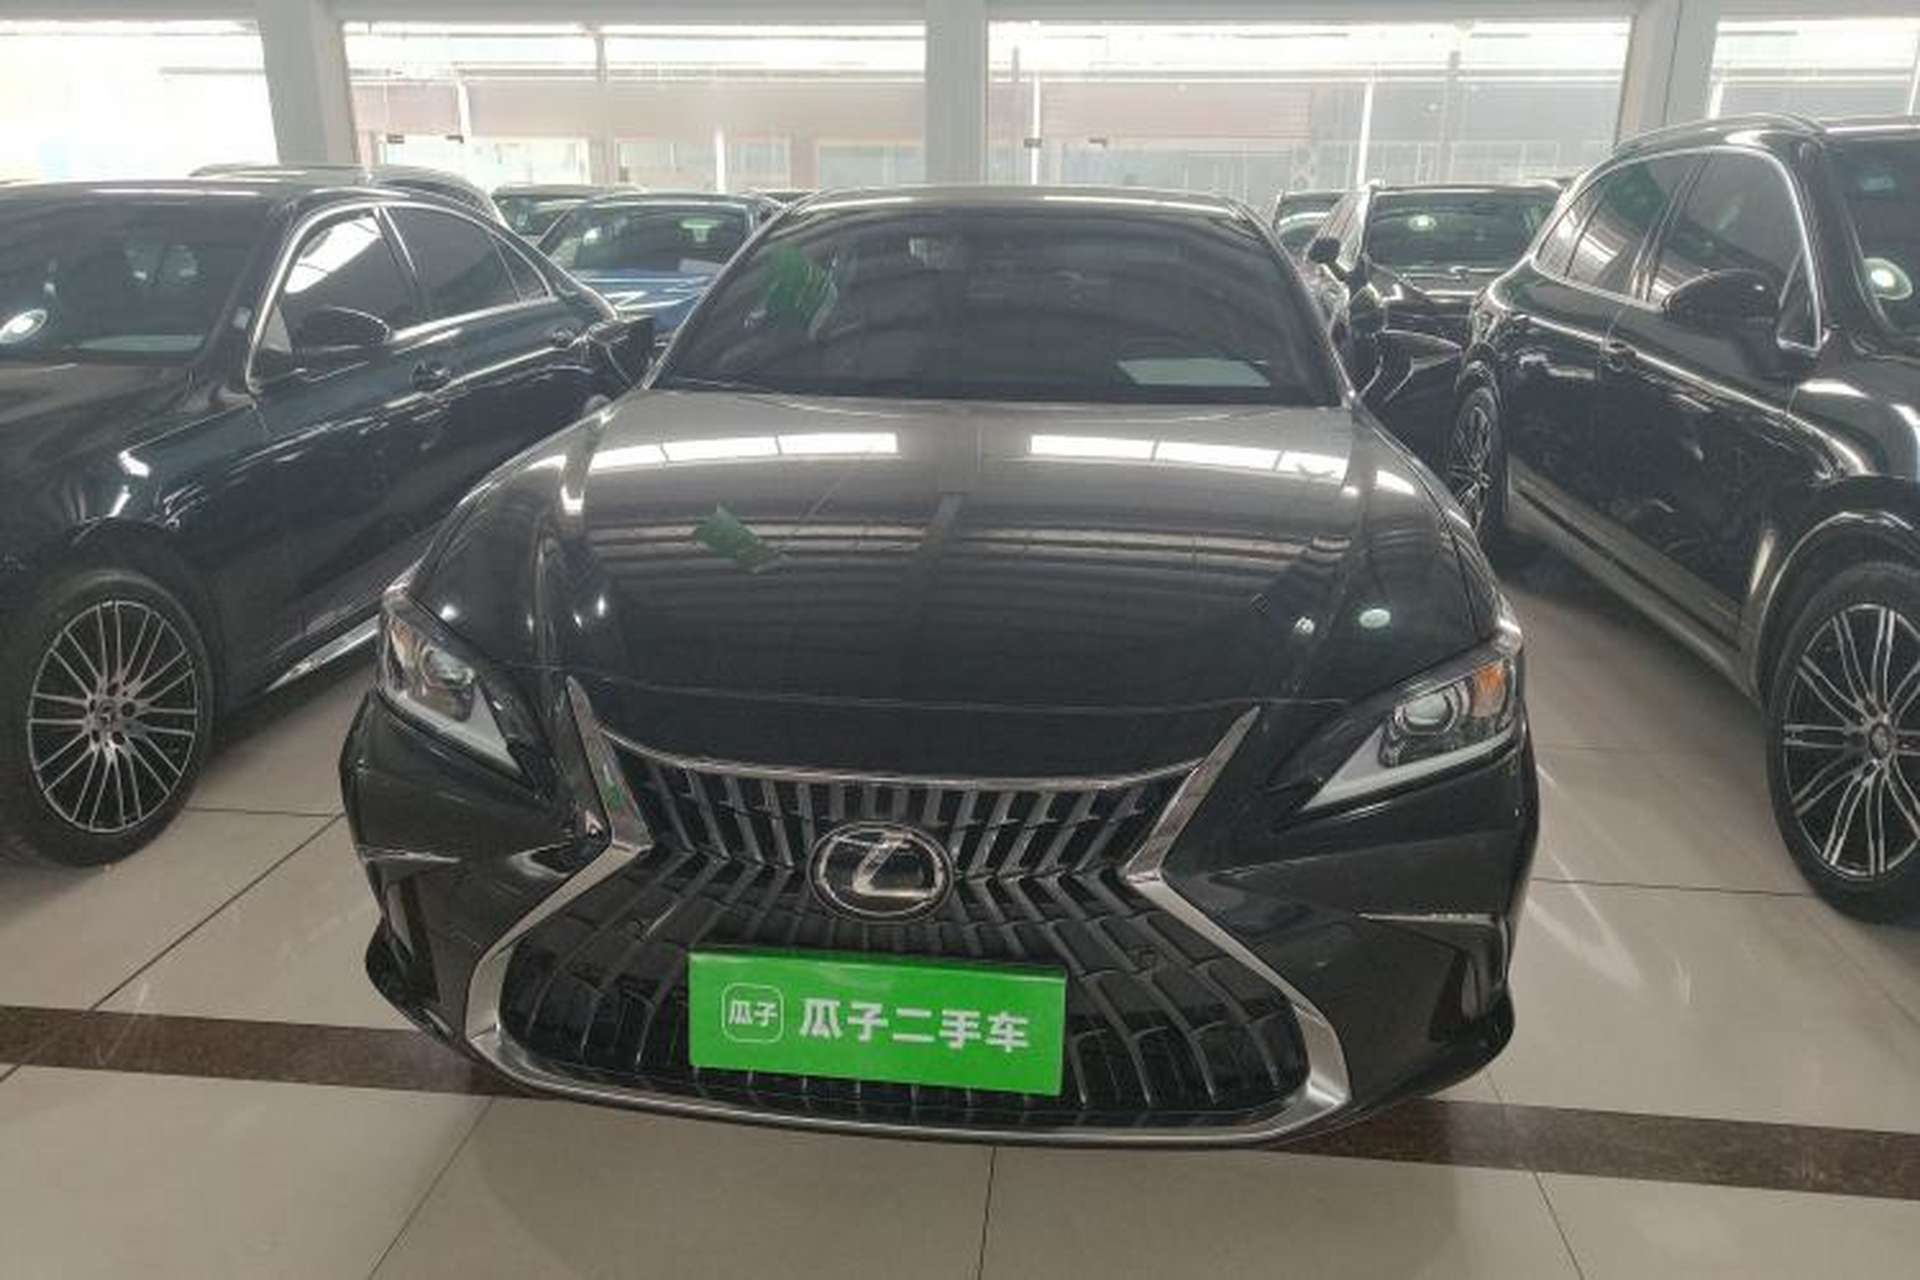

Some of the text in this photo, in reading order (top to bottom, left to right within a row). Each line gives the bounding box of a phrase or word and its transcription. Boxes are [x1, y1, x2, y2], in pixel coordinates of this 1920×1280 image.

[728, 1000, 778, 1027] 瓜子
[800, 998, 1030, 1053] 瓜子二手车
